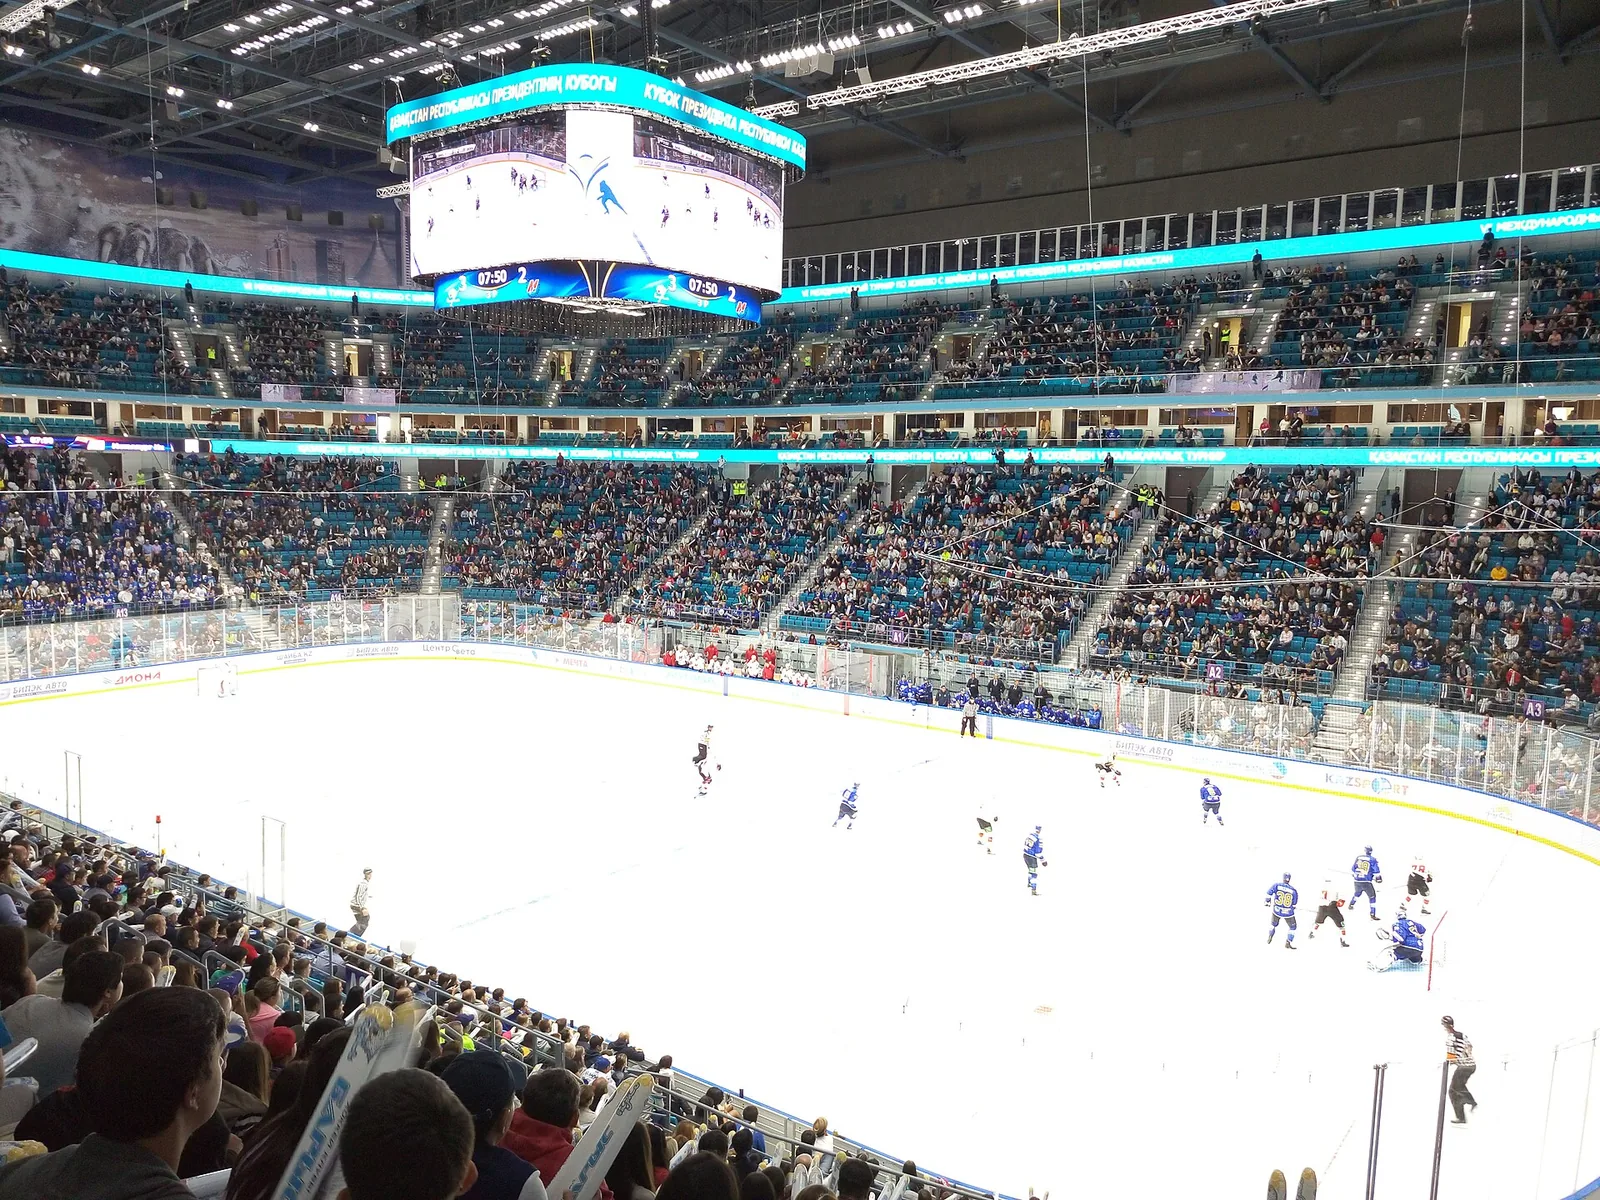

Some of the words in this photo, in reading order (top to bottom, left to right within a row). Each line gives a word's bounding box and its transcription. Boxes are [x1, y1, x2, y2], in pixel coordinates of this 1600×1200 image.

[565, 74, 617, 92] КУБОГЫ
[643, 82, 681, 109] КУБОК
[458, 275, 467, 291] 3
[478, 269, 507, 286] 07:50
[517, 266, 527, 284] 2
[668, 274, 677, 291] 3
[688, 278, 719, 296] 07:50
[727, 286, 737, 303] 2
[116, 608, 128, 618] A13
[893, 631, 902, 643] A1
[563, 658, 588, 668] МЕЧТА
[1209, 665, 1221, 679] A2
[13, 684, 43, 694] БИПЭК
[45, 681, 67, 690] АВТО
[1526, 701, 1542, 716] A3
[1115, 740, 1147, 753] БИПЭК
[1149, 747, 1174, 757] АВТО
[1274, 890, 1293, 908] 38
